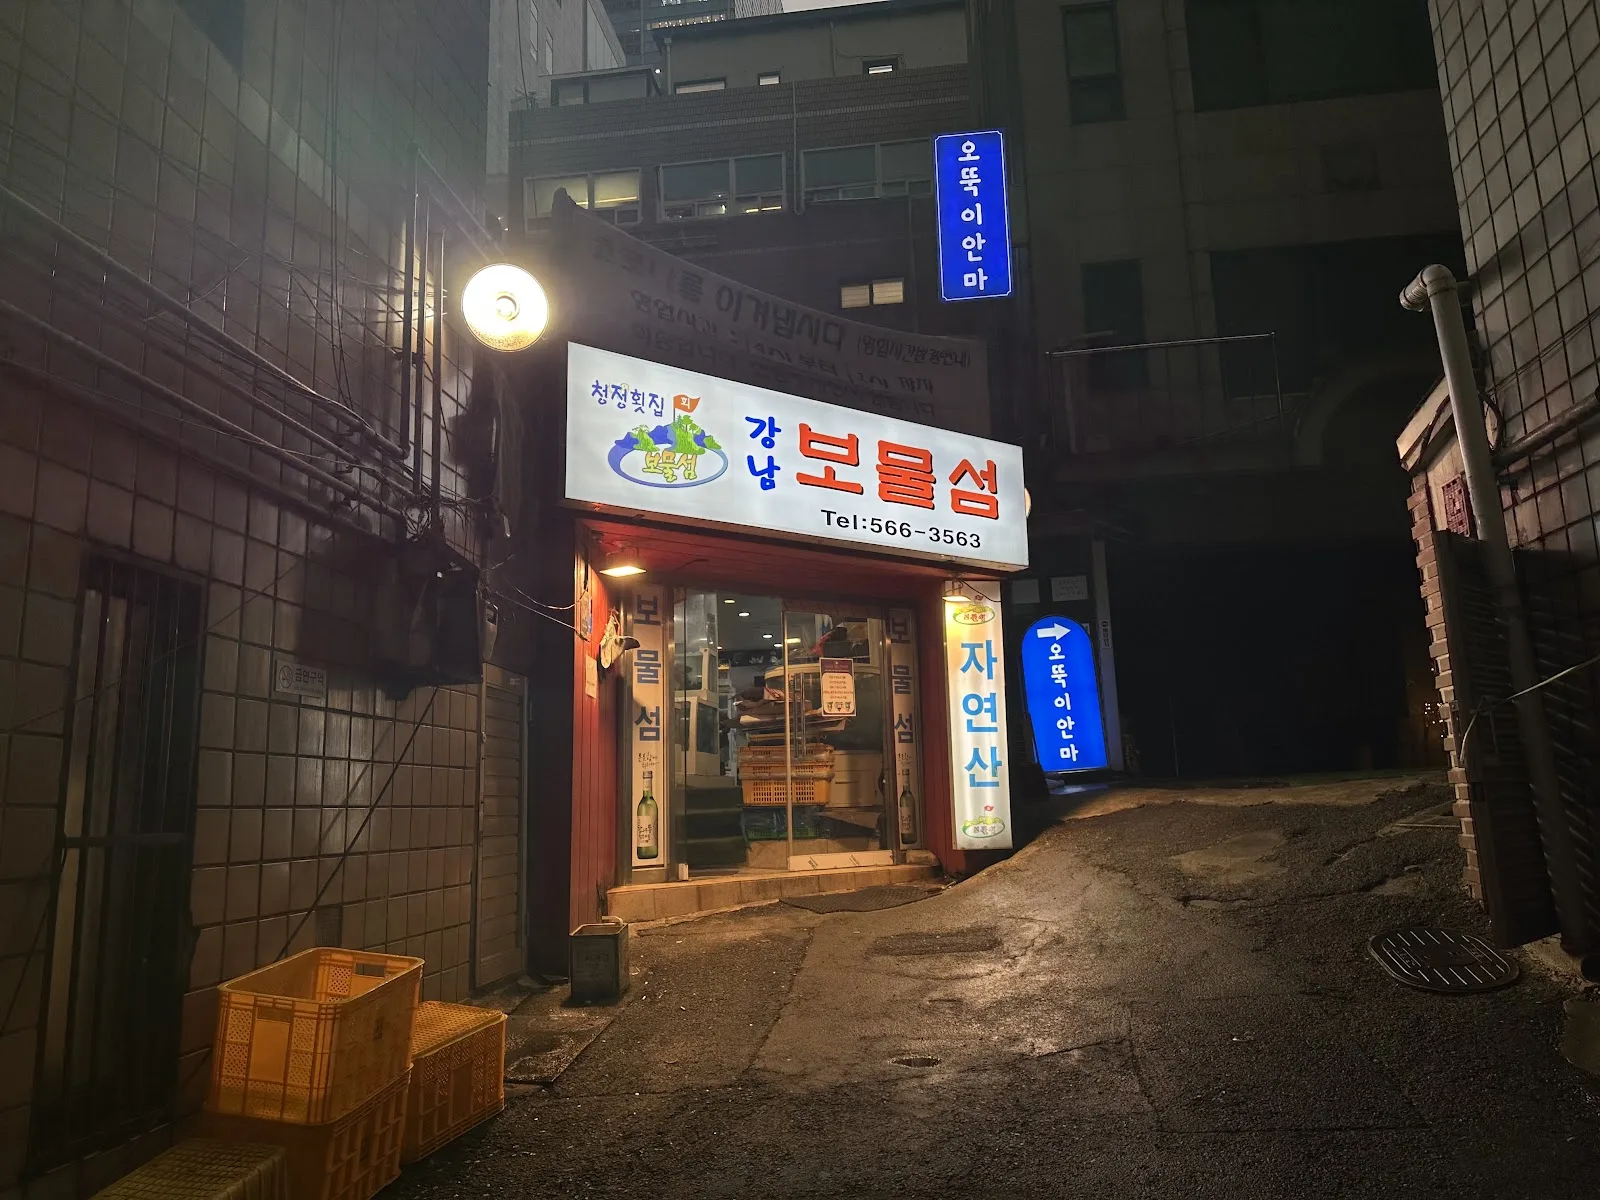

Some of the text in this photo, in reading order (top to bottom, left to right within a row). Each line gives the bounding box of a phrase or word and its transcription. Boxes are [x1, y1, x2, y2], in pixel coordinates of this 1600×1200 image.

[957, 140, 989, 291] 오뚝이안마
[715, 284, 847, 352] 이겨냅시다
[591, 379, 665, 418] 청정횟집
[680, 396, 691, 410] 회
[641, 449, 698, 483] 보물섬
[745, 415, 782, 491] 강남
[795, 423, 999, 520] 보물섬
[820, 508, 982, 549] Tel:566-3563
[295, 668, 325, 687] 금연구역
[634, 594, 662, 741] 보물섬
[891, 618, 914, 744] 보물섬
[1048, 642, 1079, 762] 오뚝이안마
[960, 639, 1003, 788] 자연산
